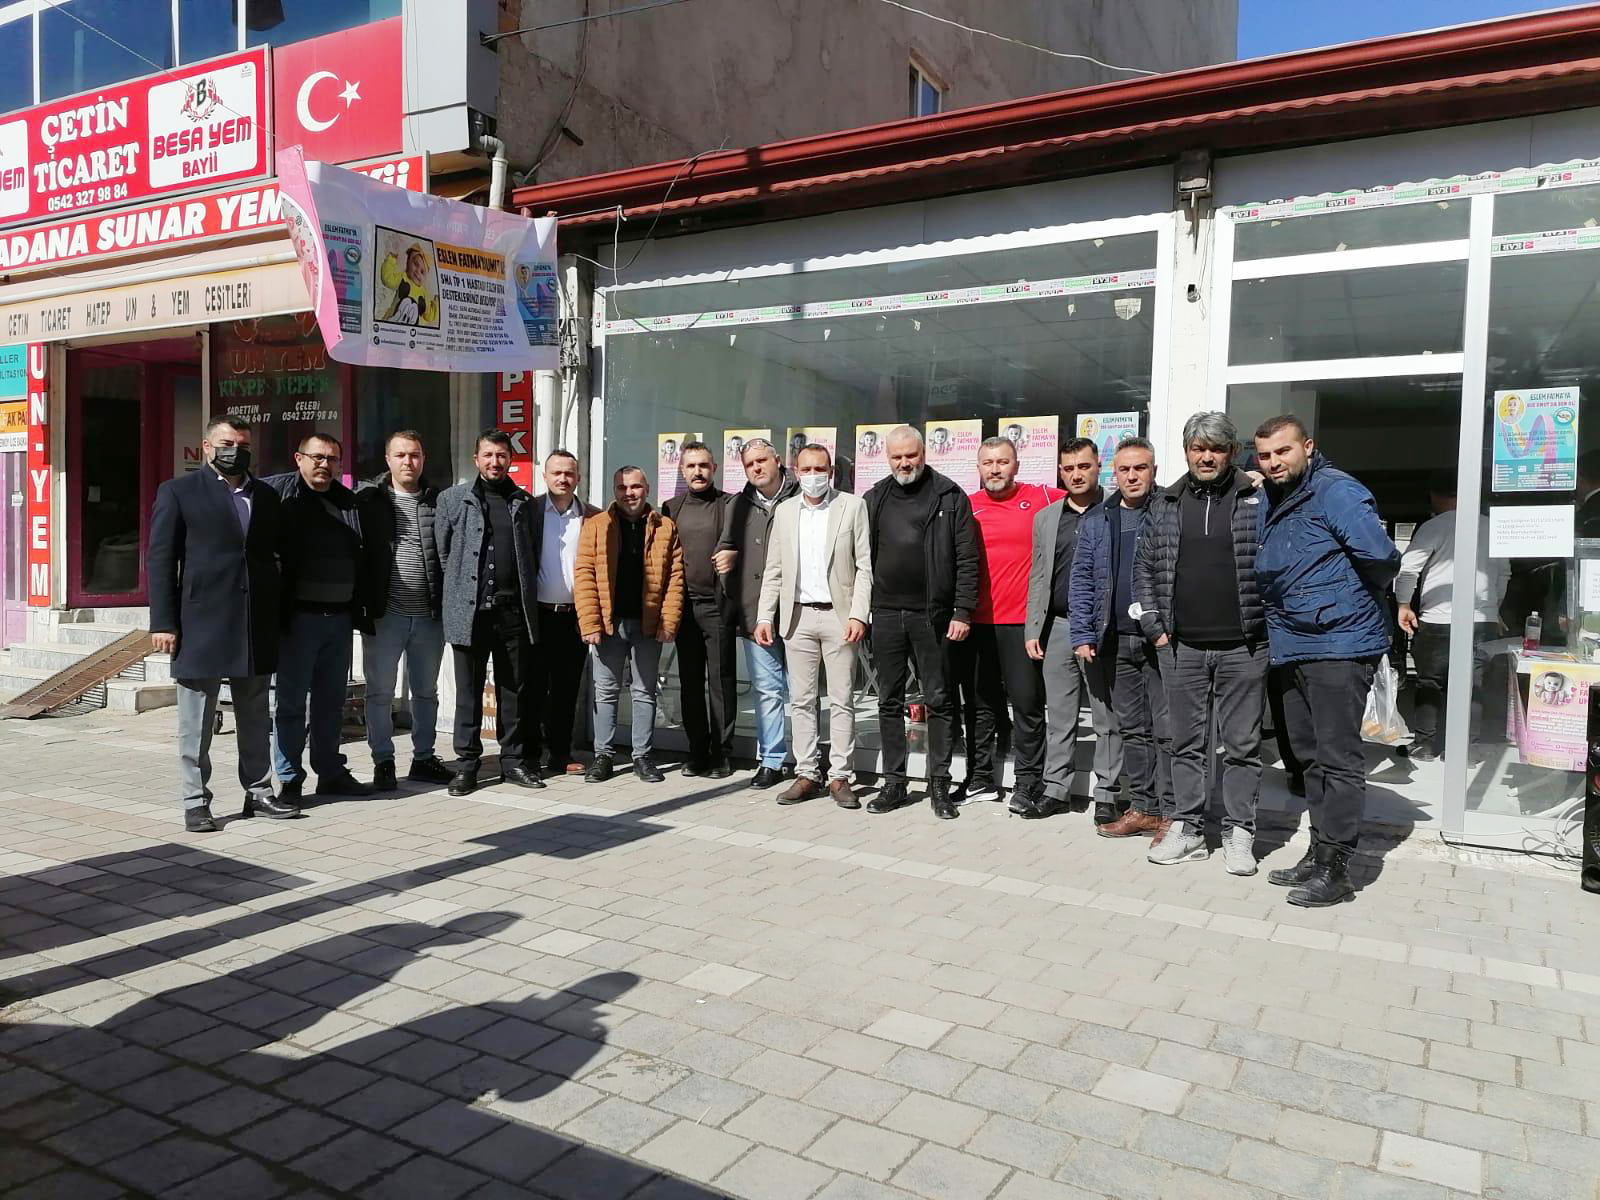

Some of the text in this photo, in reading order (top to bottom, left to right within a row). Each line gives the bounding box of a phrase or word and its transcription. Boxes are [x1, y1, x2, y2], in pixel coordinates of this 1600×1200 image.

[41, 96, 129, 154] ÇETİN
[153, 115, 252, 160] BESA YEM
[0, 166, 25, 192] EM
[33, 142, 140, 193] TİCARET
[48, 182, 128, 211] 0542 327 98 84
[0, 188, 286, 267] ADANA SUNAR YEM
[41, 307, 72, 333] TİCARET
[125, 296, 137, 321] UN
[172, 289, 190, 315] YEM
[205, 281, 252, 314] ÇEŞİTLERİ
[301, 411, 315, 420] 327
